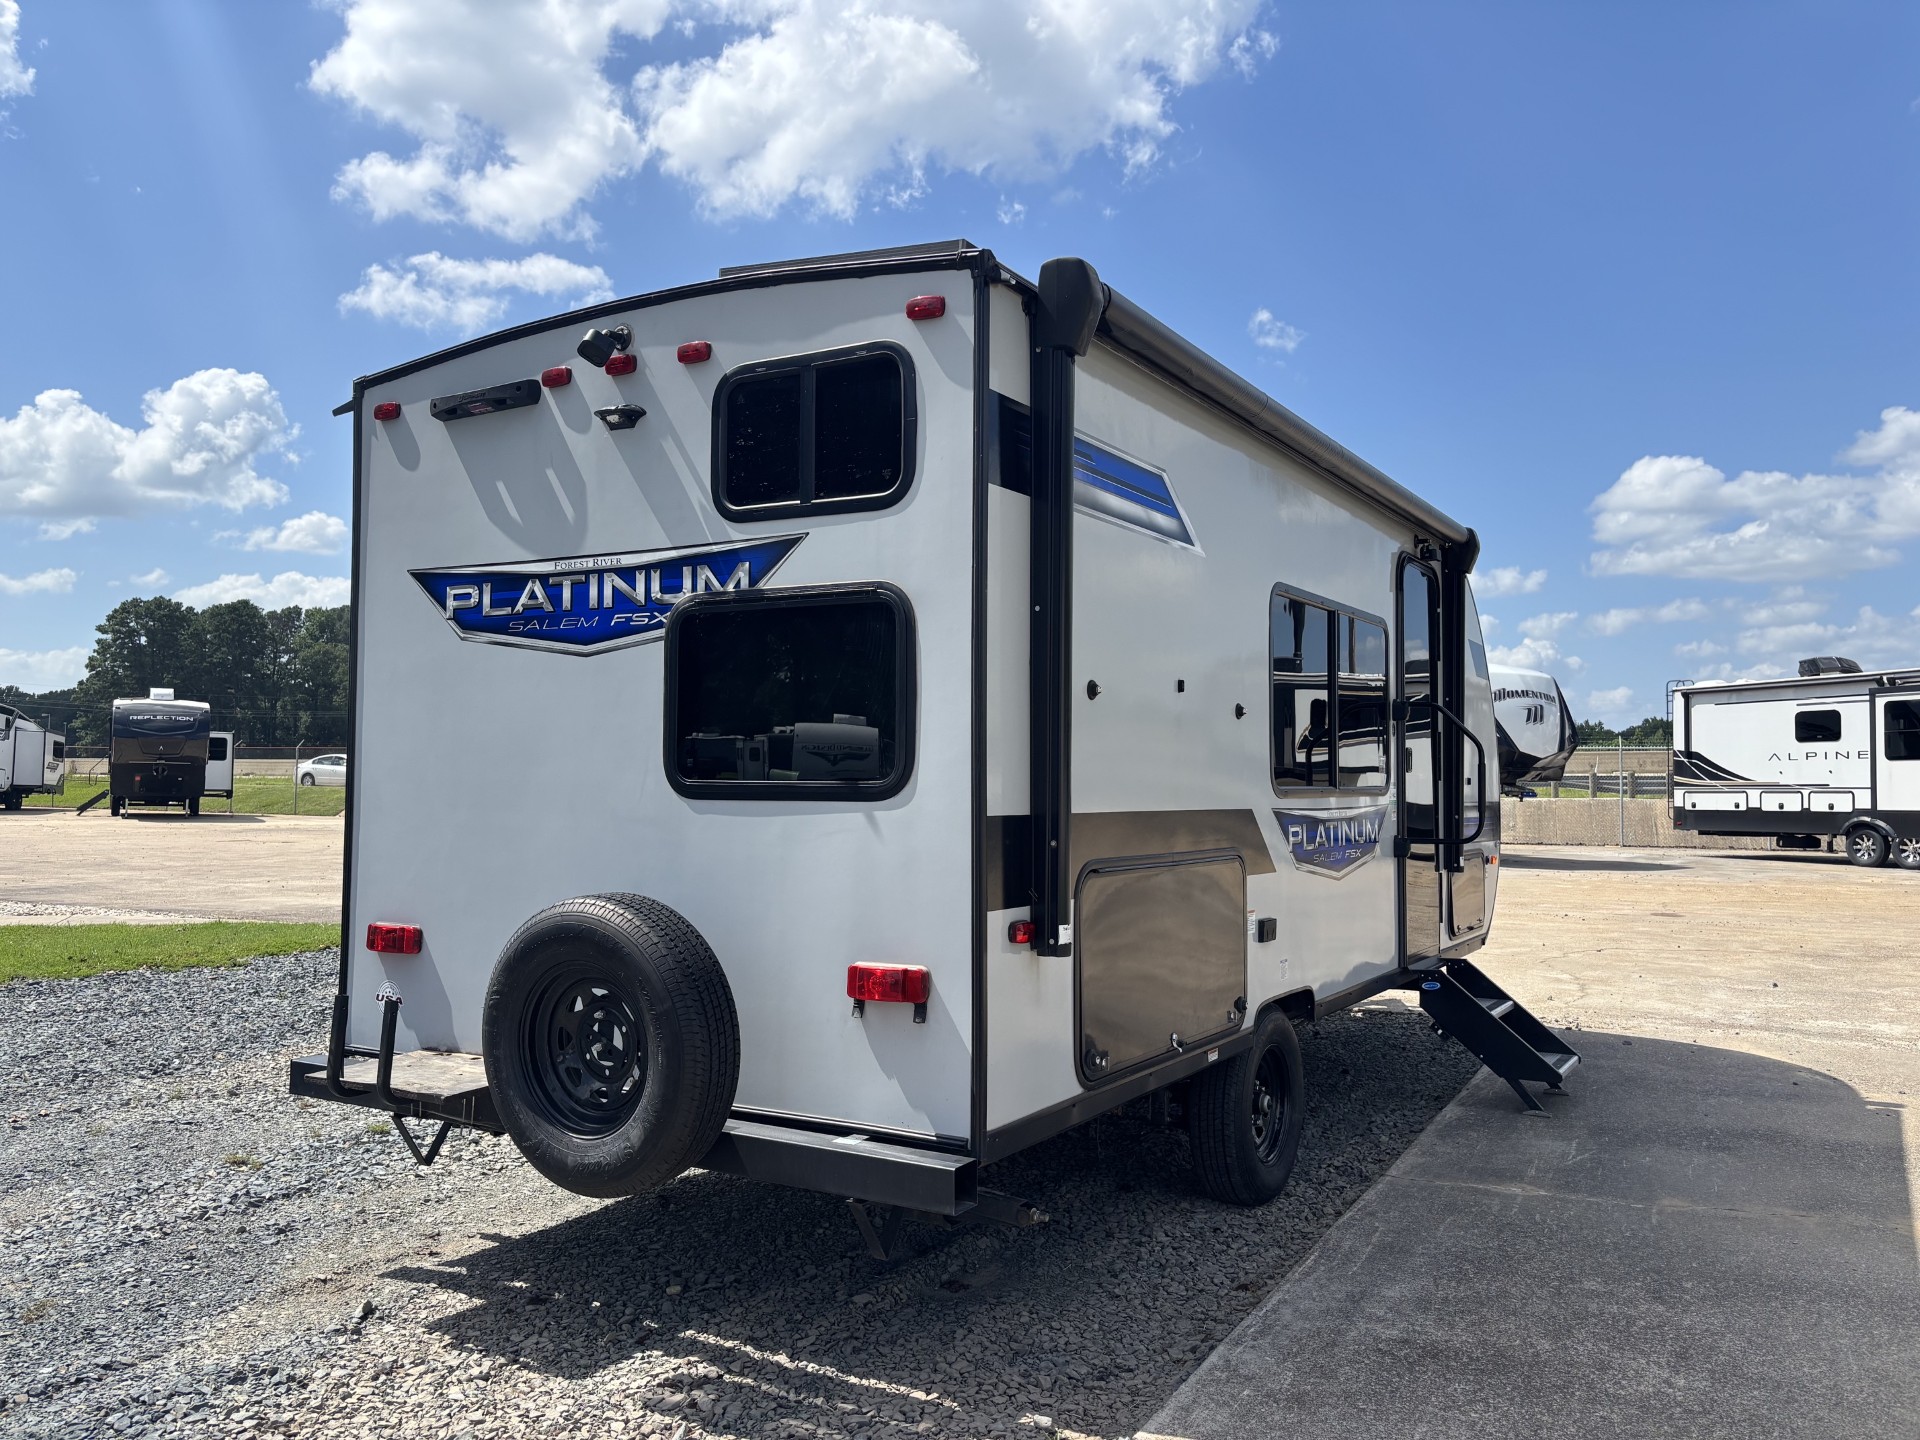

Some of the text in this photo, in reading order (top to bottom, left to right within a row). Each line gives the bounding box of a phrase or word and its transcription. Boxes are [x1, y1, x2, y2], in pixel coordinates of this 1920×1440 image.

[554, 558, 622, 570] FOREST RIVER
[446, 561, 750, 619] PLATINUM
[508, 611, 671, 632] SALEM FSX
[1768, 750, 1869, 761] ALPINE
[1288, 819, 1379, 854] PLATINUM
[1313, 848, 1362, 863] SALEM FSX
[376, 993, 403, 1005] USA
